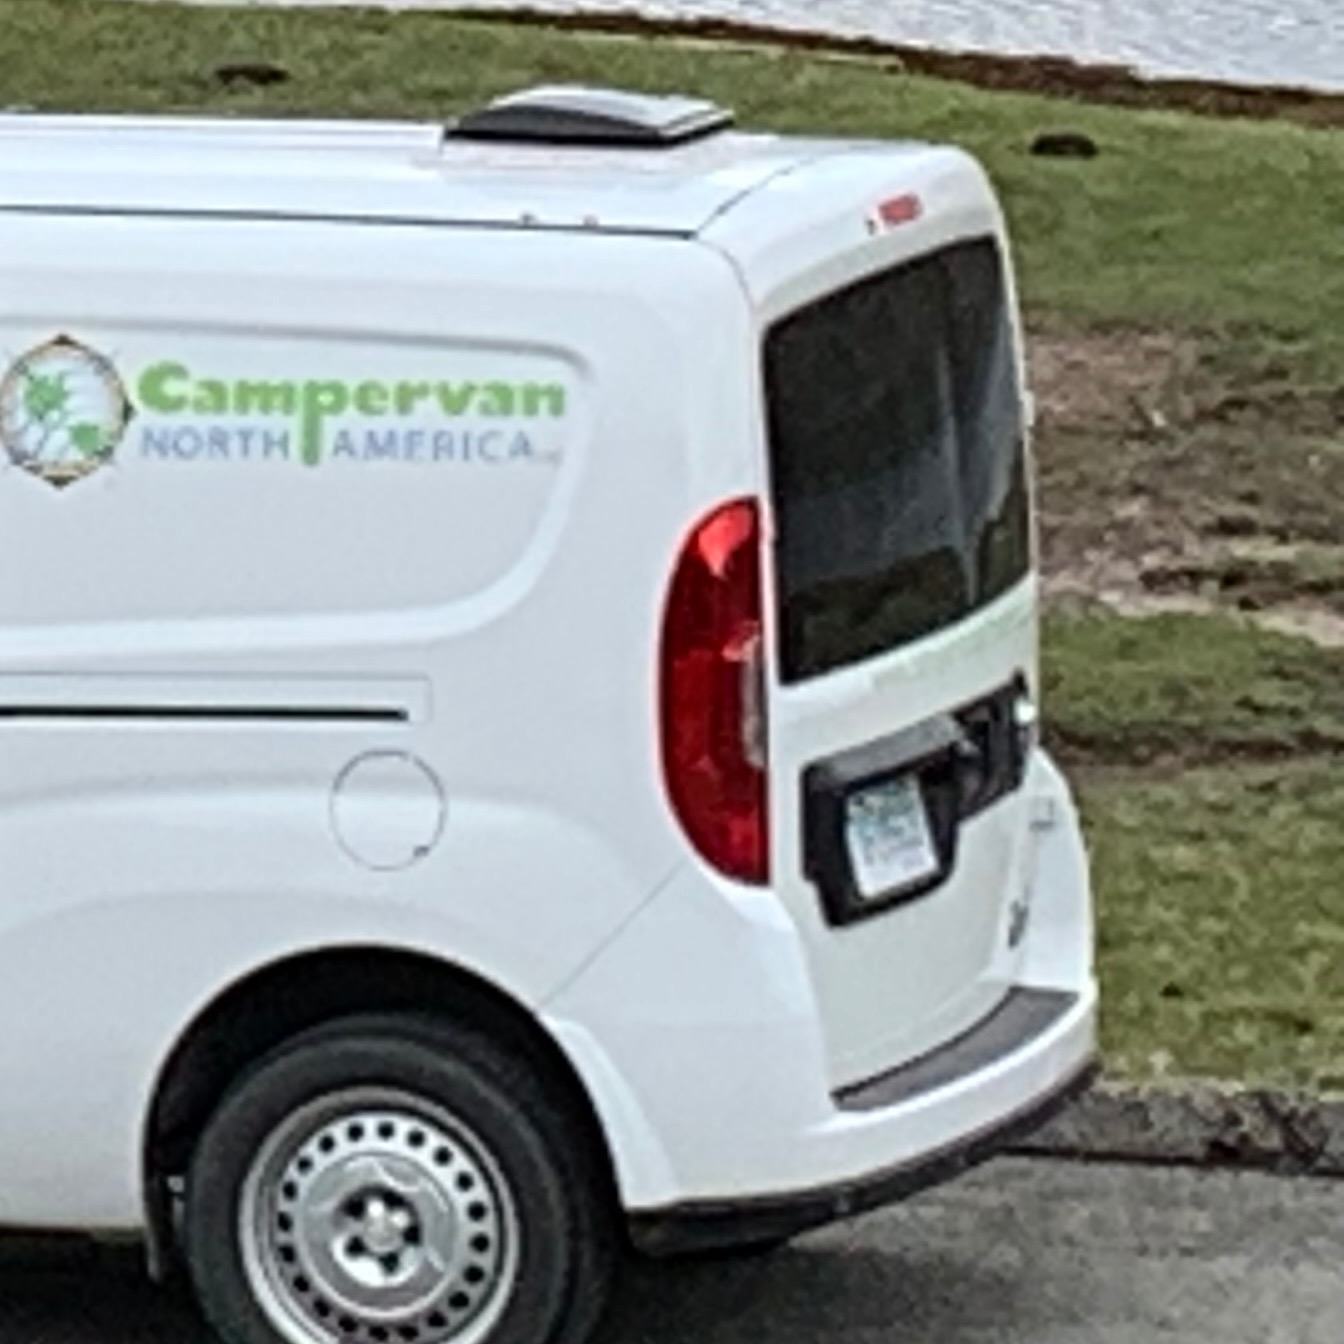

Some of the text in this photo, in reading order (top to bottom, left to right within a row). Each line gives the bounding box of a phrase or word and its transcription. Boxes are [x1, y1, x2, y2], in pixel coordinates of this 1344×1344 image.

[138, 361, 566, 466] Campervan
[142, 424, 290, 460] NORTH
[331, 428, 533, 462] AMERICA
